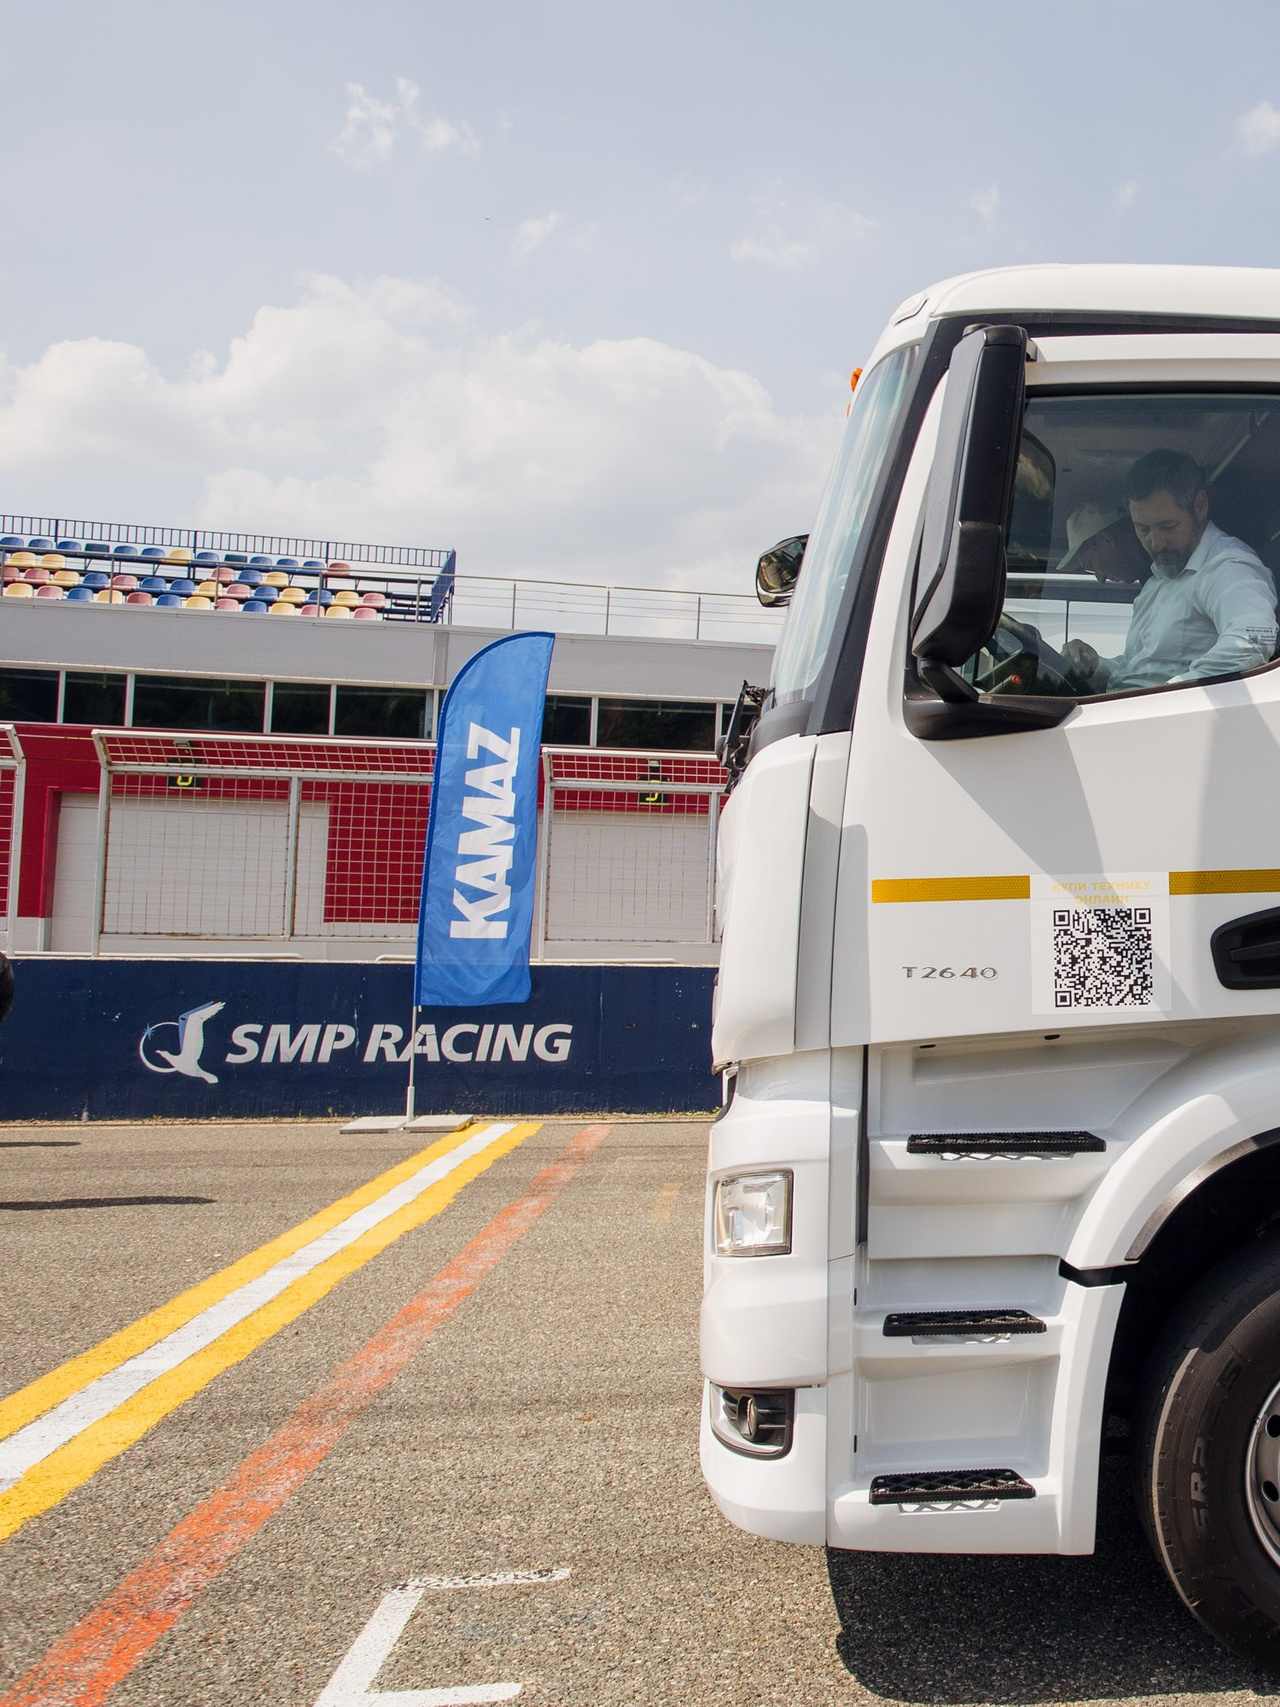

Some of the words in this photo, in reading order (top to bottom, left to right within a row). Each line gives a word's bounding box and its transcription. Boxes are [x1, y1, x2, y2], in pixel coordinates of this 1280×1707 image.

[450, 722, 521, 938] KAMAZ
[1053, 882, 1087, 893] КУПИ
[1091, 880, 1151, 892] ТЕХНИКУ
[902, 966, 998, 979] T2640
[225, 1023, 356, 1064] SMP
[363, 1023, 573, 1063] RACING
